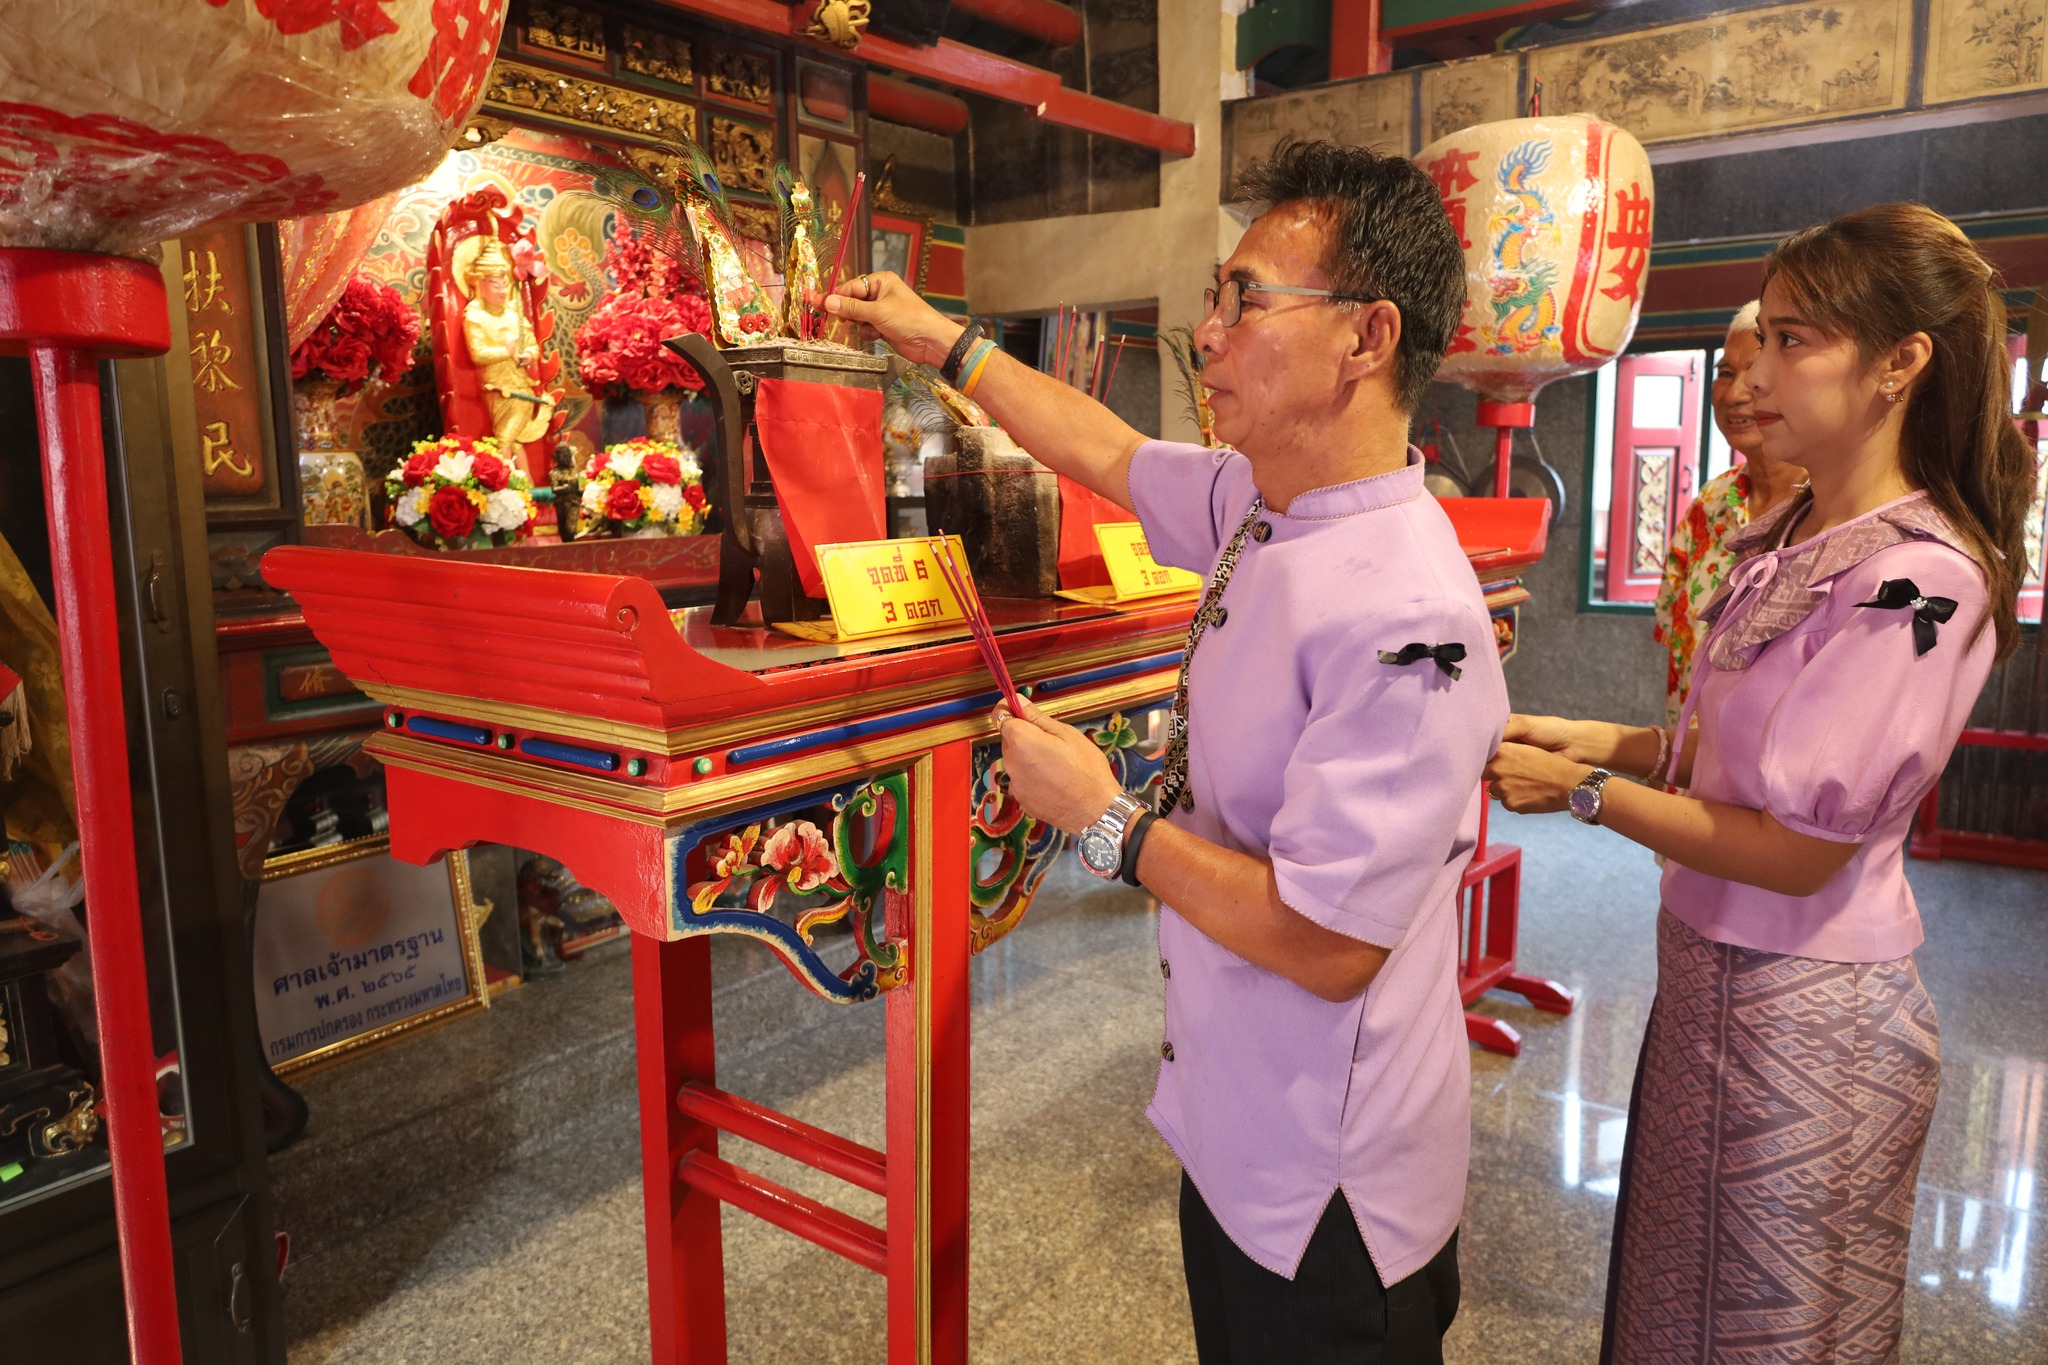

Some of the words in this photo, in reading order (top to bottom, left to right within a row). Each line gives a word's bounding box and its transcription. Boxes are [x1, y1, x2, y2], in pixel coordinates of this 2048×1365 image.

[867, 546, 909, 592] จุดที่
[1140, 569, 1151, 587] 3
[882, 601, 898, 623] 3
[904, 598, 944, 620] ดอก
[272, 928, 444, 996] ศาลเจ้ามาตรฐาน
[313, 985, 355, 1010] พ.ศ.
